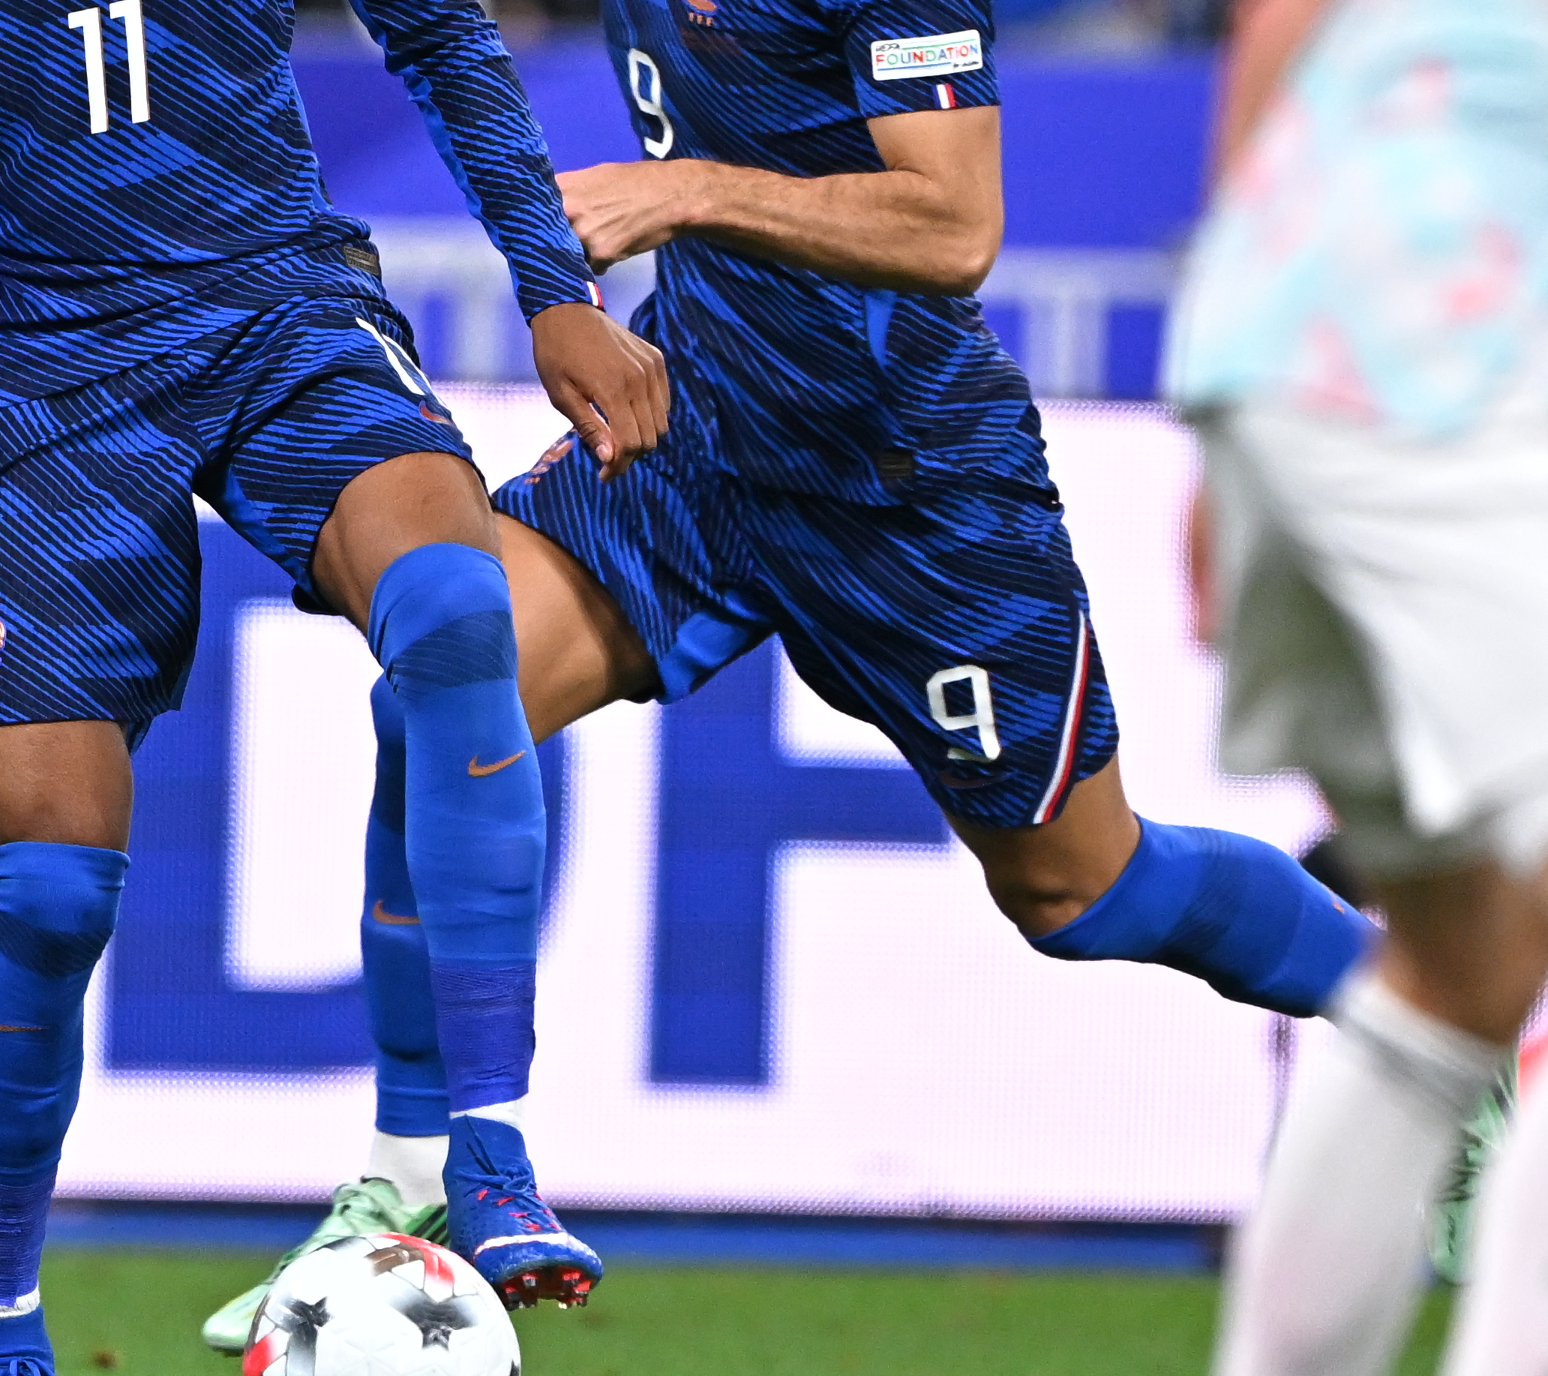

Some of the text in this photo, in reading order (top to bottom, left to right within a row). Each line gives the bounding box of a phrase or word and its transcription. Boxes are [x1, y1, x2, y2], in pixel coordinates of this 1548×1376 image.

[627, 47, 674, 159] 9
[875, 44, 979, 66] FOUNDATION
[926, 664, 1001, 764] 9
